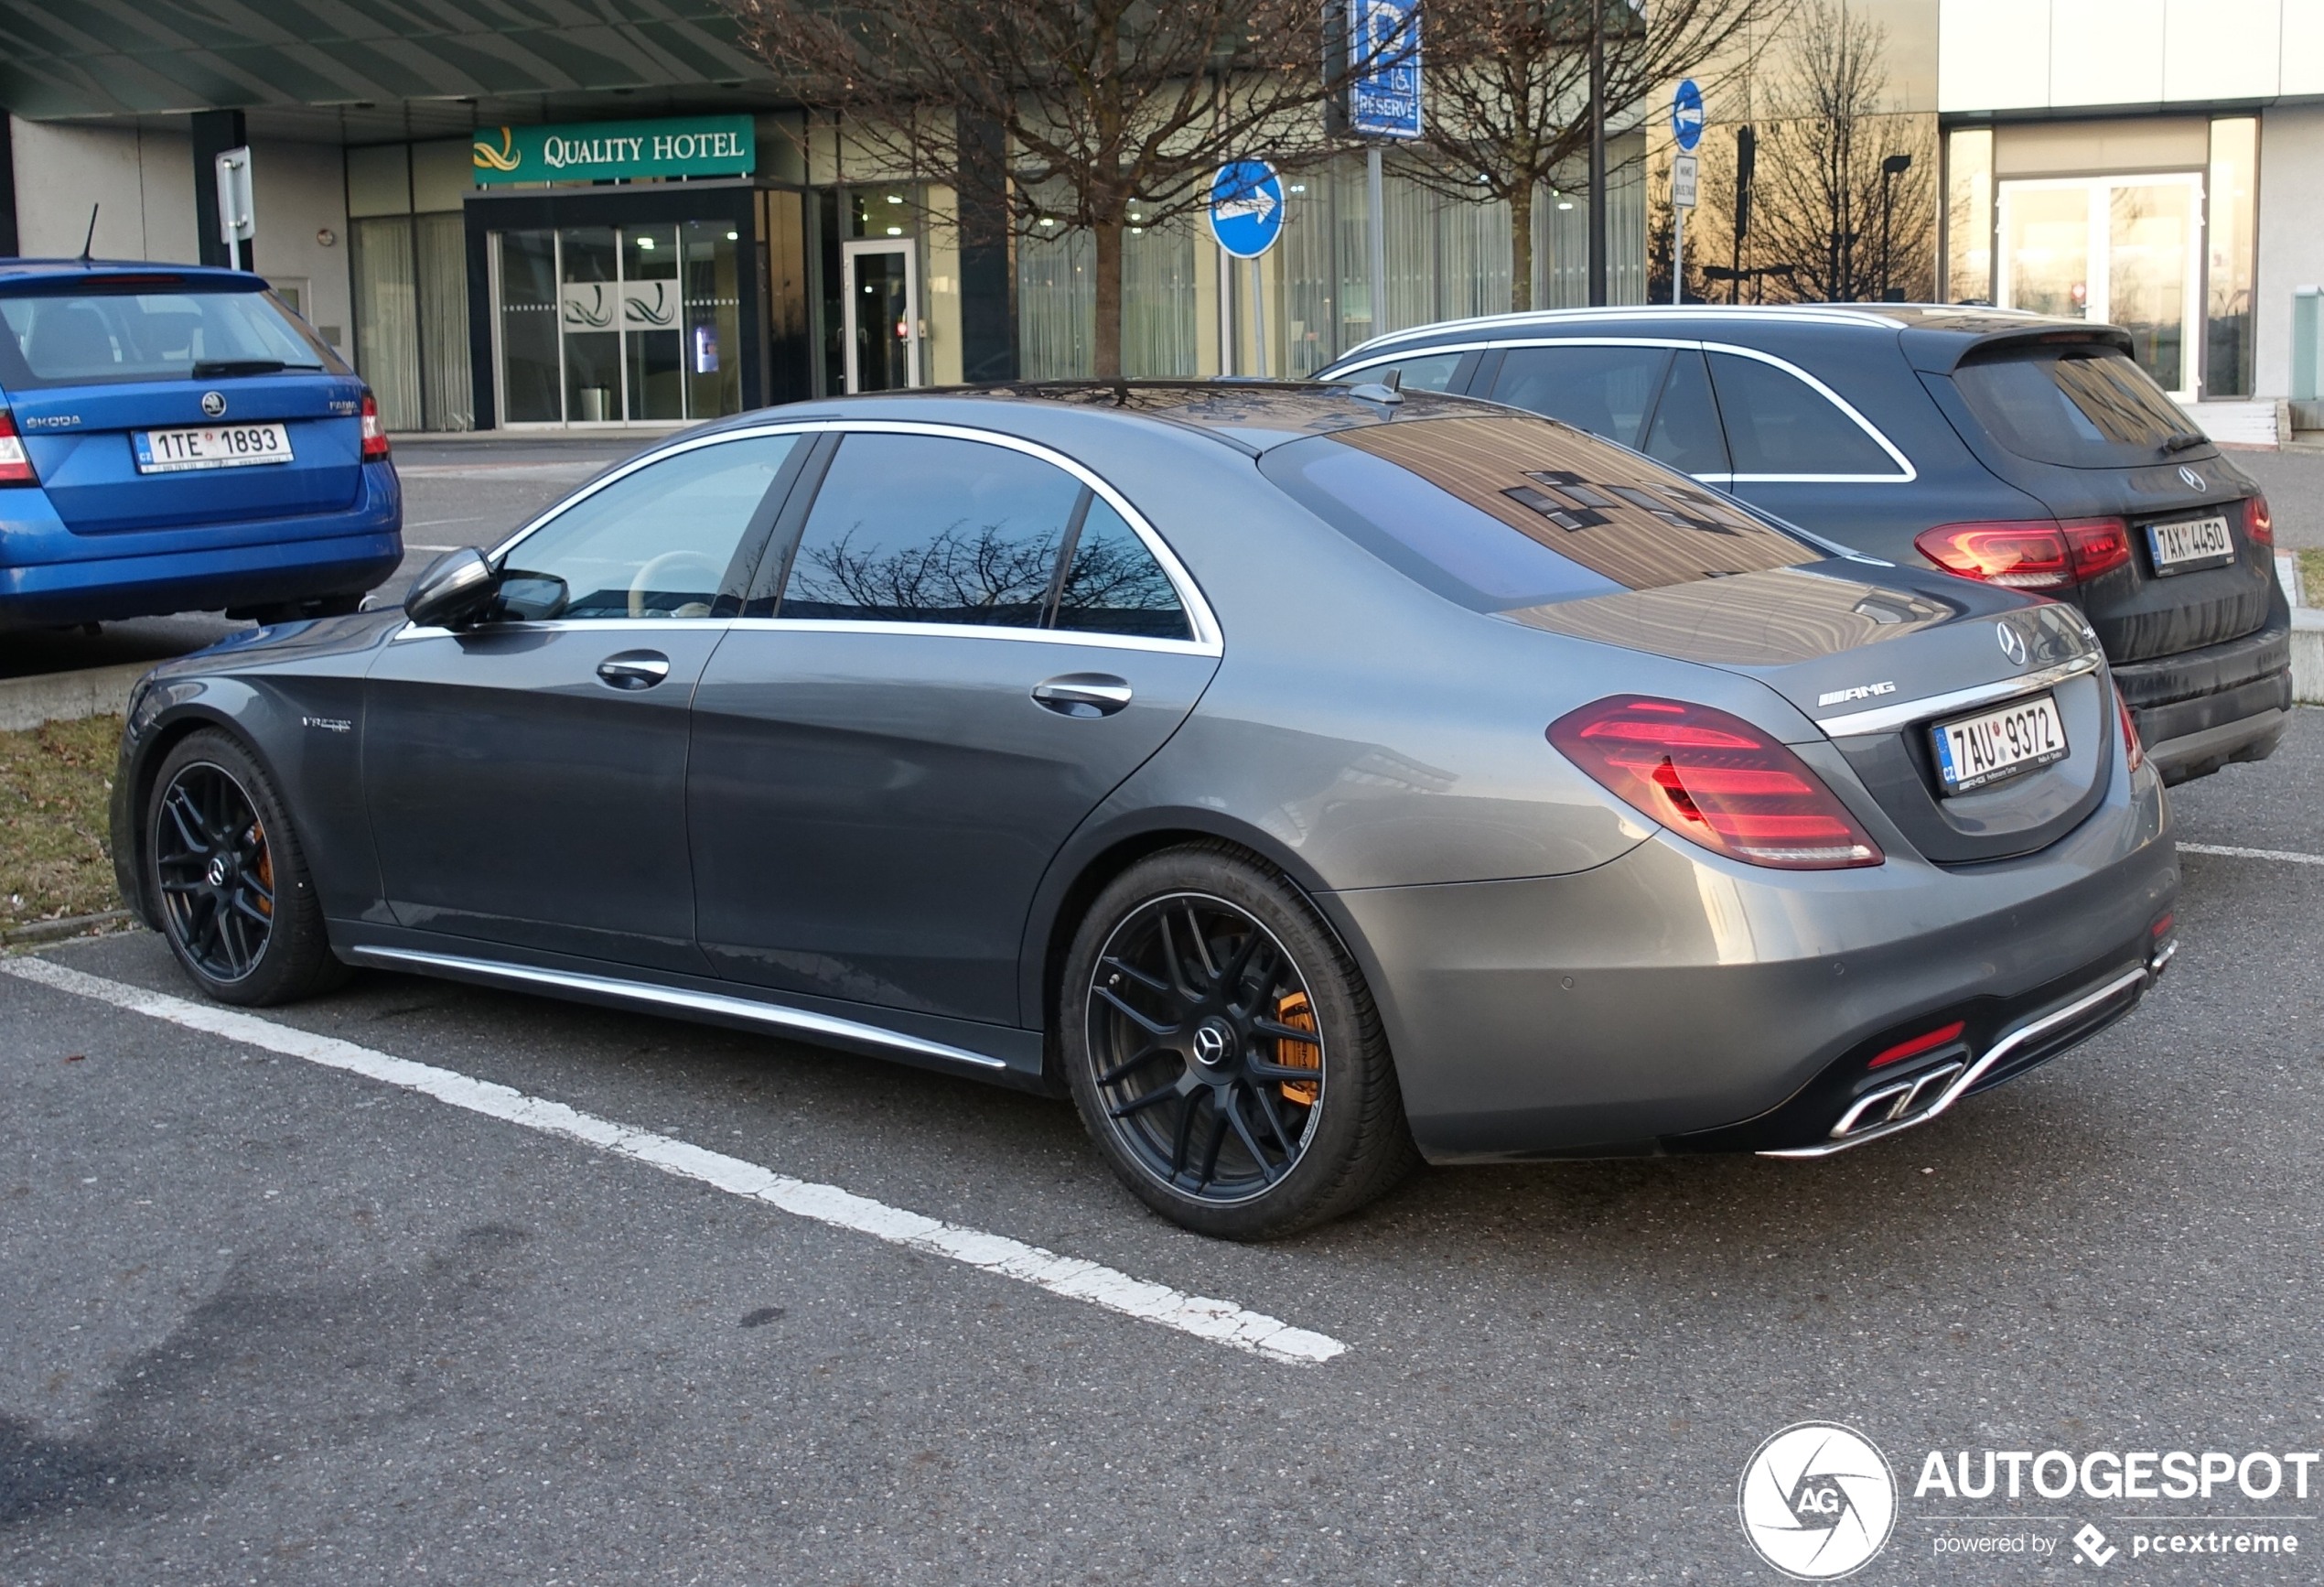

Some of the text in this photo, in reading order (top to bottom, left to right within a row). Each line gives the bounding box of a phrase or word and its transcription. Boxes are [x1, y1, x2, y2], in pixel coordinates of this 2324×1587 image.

[1367, 0, 1407, 83] P
[543, 132, 745, 168] QUALITY HOTEL
[158, 428, 278, 459] 1TE 1893
[2157, 522, 2225, 560] 7AX 4450
[1843, 681, 1896, 702] AMG
[1953, 707, 2055, 776] 7AU 9372
[1942, 766, 1955, 781] CZ
